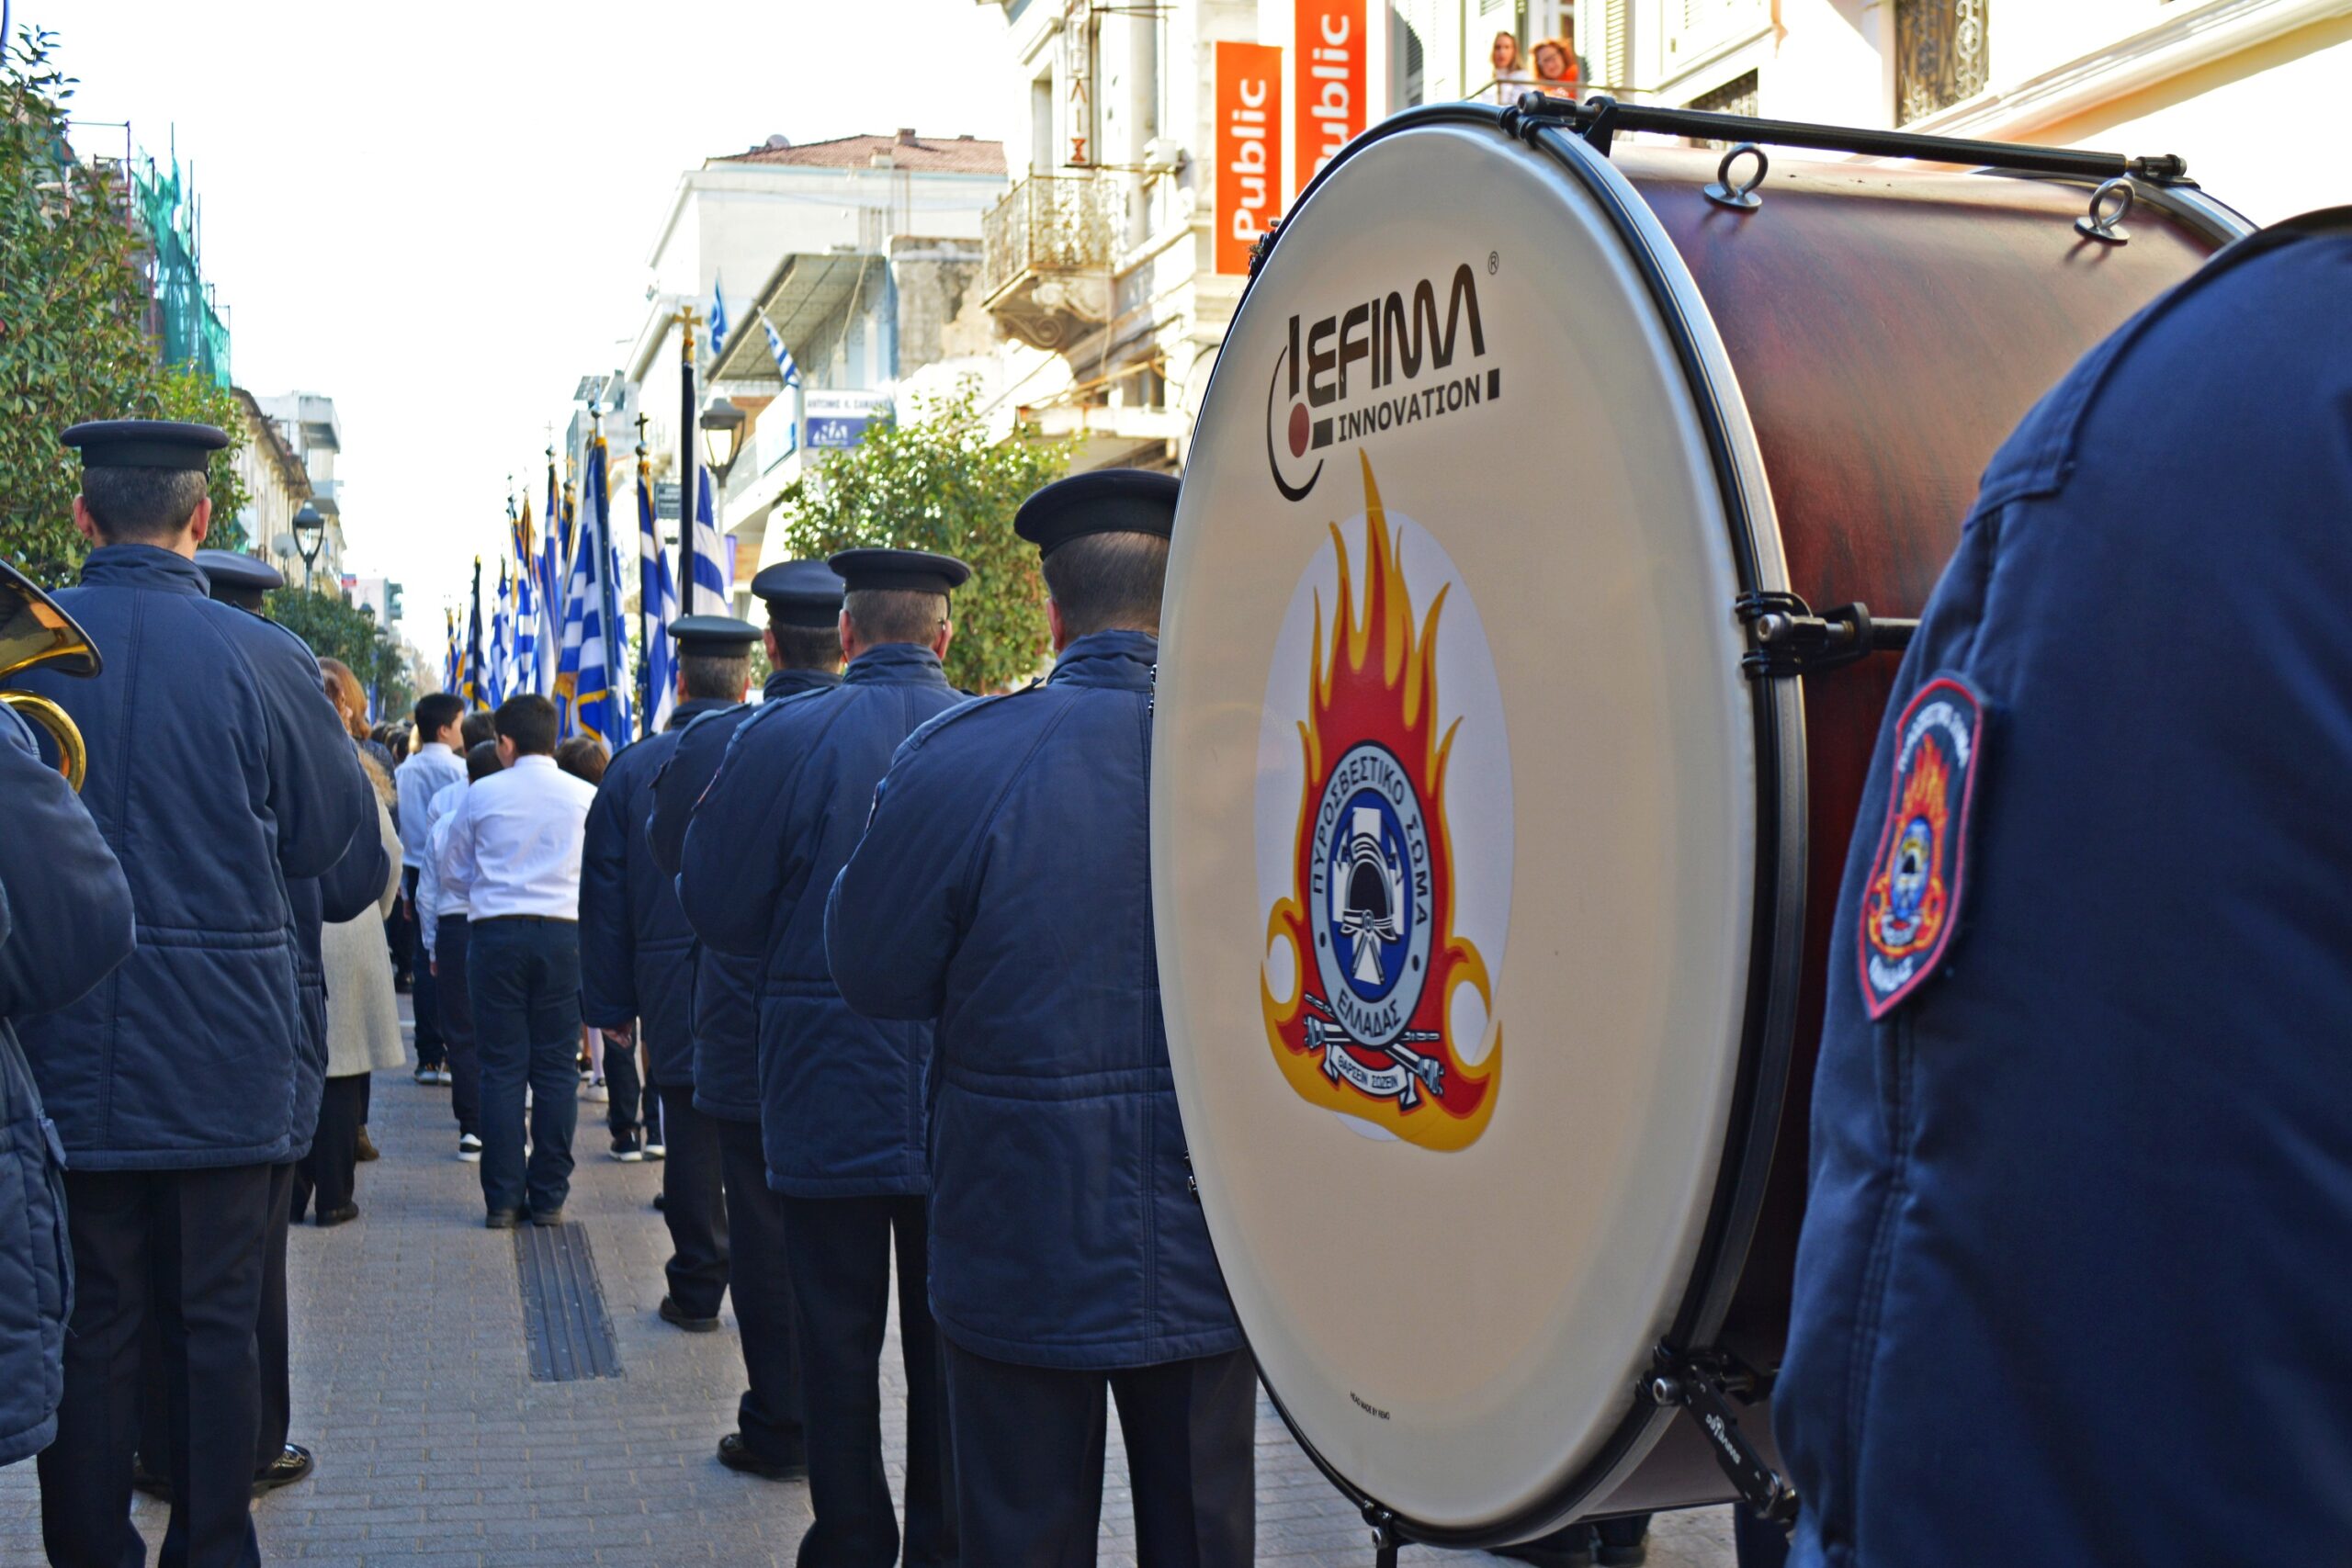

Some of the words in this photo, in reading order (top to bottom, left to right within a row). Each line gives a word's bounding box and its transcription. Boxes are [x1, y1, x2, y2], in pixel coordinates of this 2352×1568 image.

[1311, 13, 1351, 176] ublic
[1230, 77, 1267, 242] Public
[1337, 374, 1481, 443] INNOVATION
[1313, 755, 1406, 895] ΠΥΡΟΣΒΕΣΤΙΚΟ
[1406, 812, 1430, 927] ΣΩΜΑ
[1337, 987, 1402, 1038] ΕΛΛΑΔΑΣ
[1337, 1055, 1369, 1086] ΘΑΡΣΕΙΝ
[1360, 1401, 1372, 1415] MADE
[1372, 1406, 1378, 1416] BY
[1377, 1409, 1391, 1420] REMO
